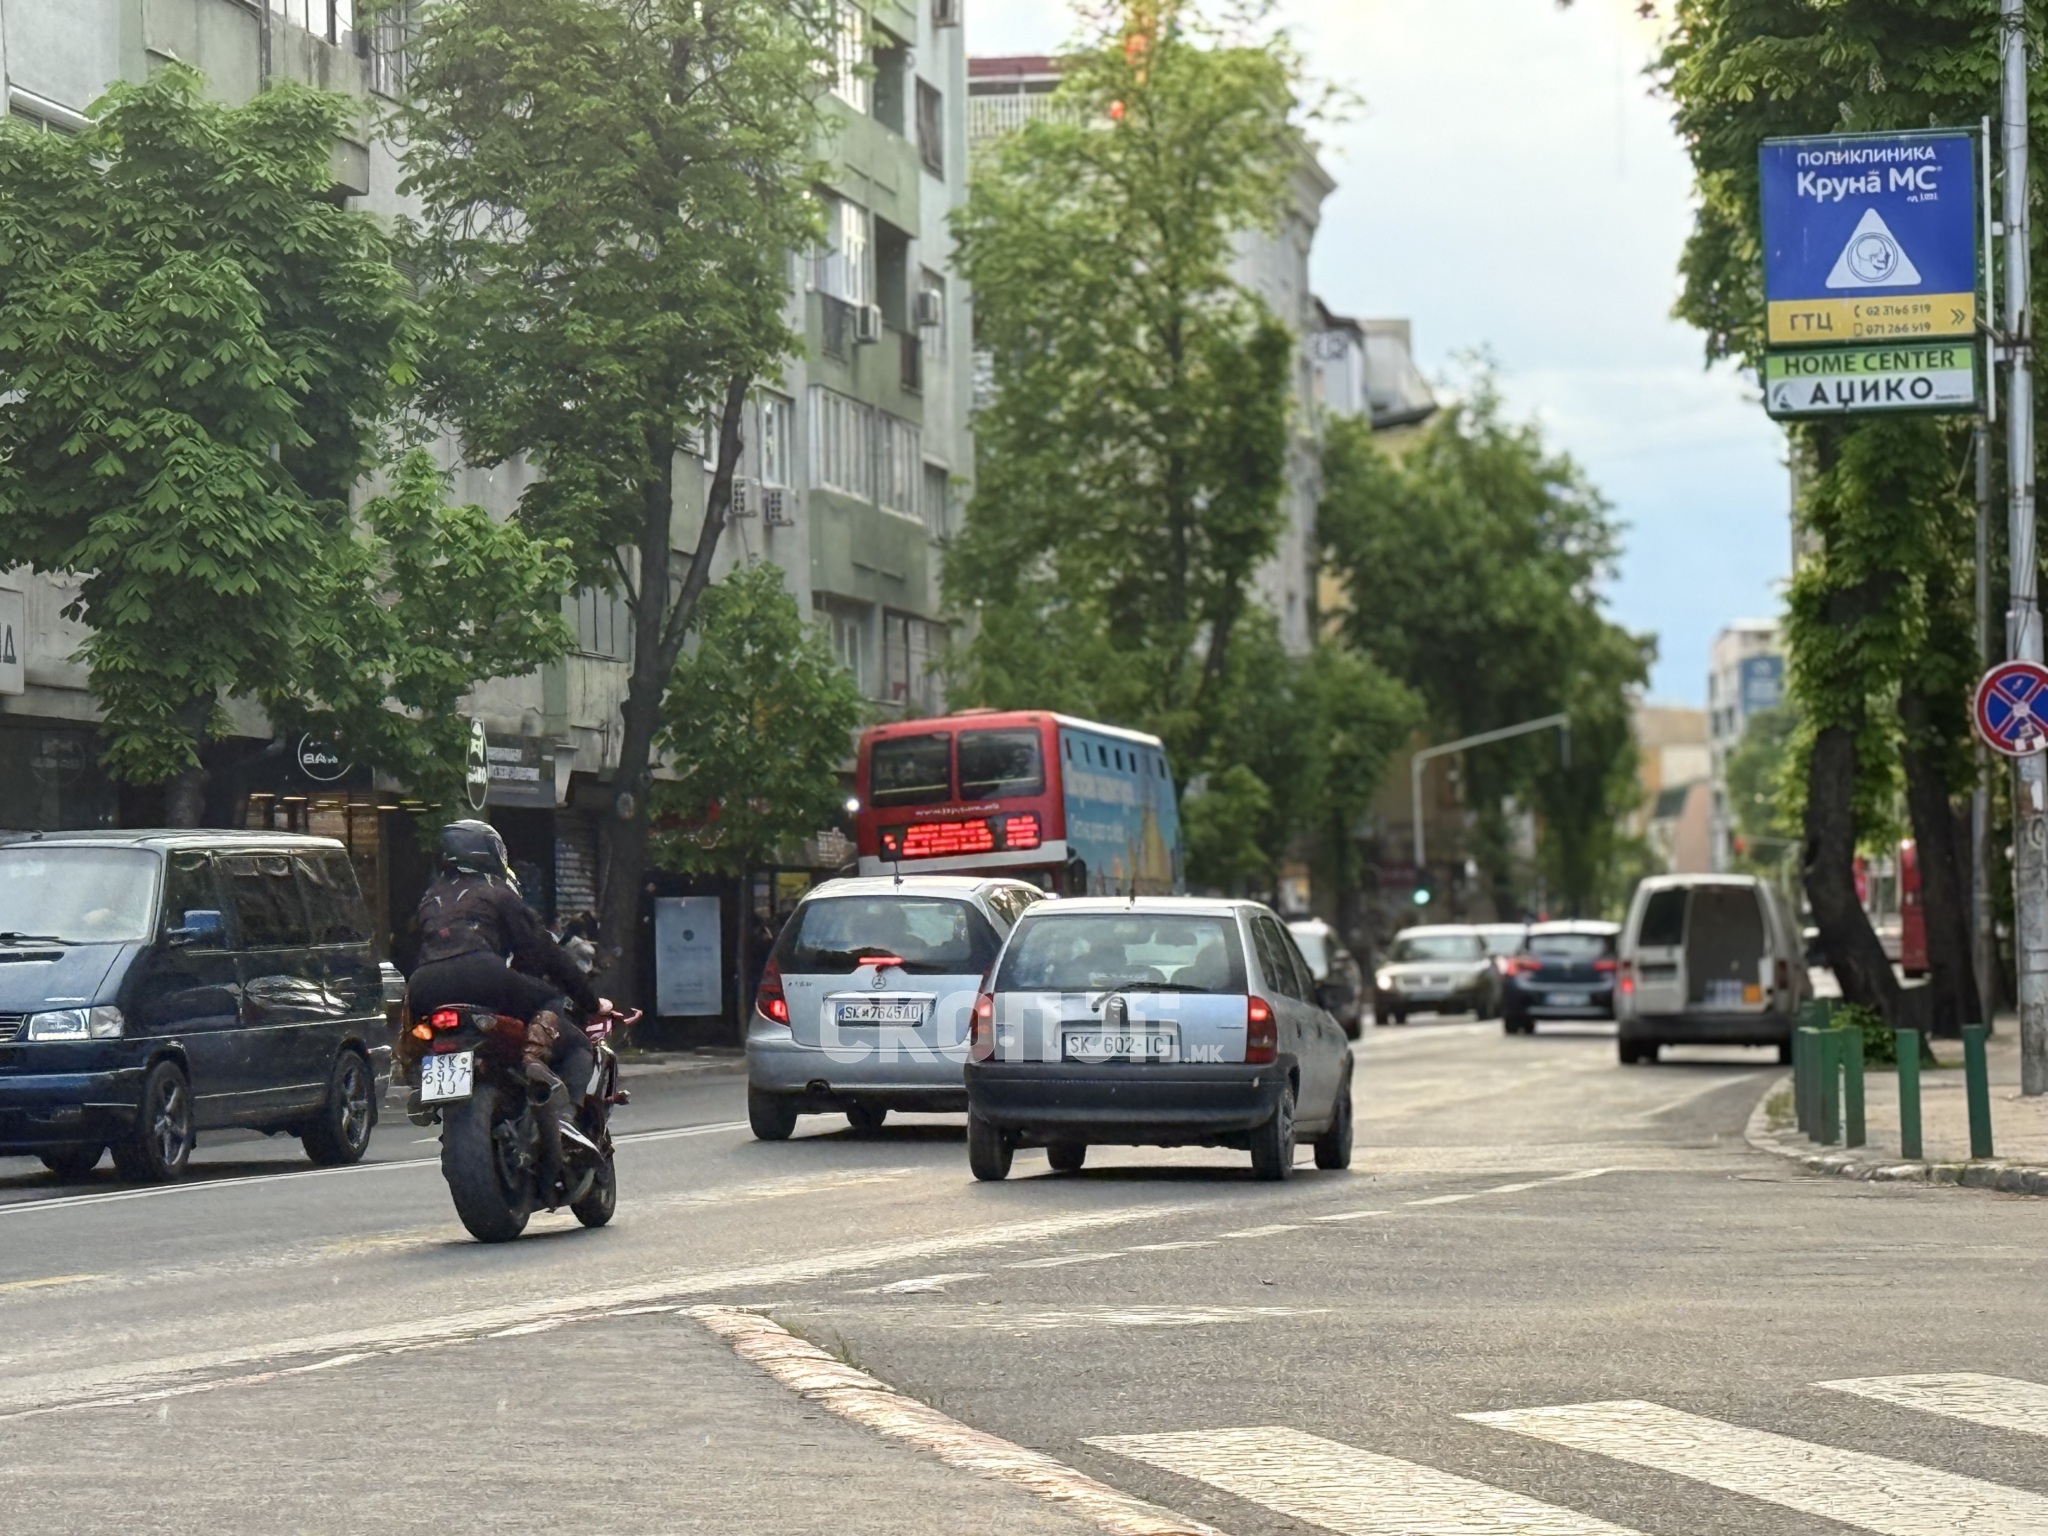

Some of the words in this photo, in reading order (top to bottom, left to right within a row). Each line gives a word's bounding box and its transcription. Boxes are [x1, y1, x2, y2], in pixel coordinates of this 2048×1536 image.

[1797, 146, 1936, 166] ПОЛИКЛИНИКА
[1790, 312, 1833, 331] ГТЦ
[1784, 355, 1857, 375] HOME
[1863, 350, 1955, 371] CENTER
[437, 1054, 457, 1069] SK
